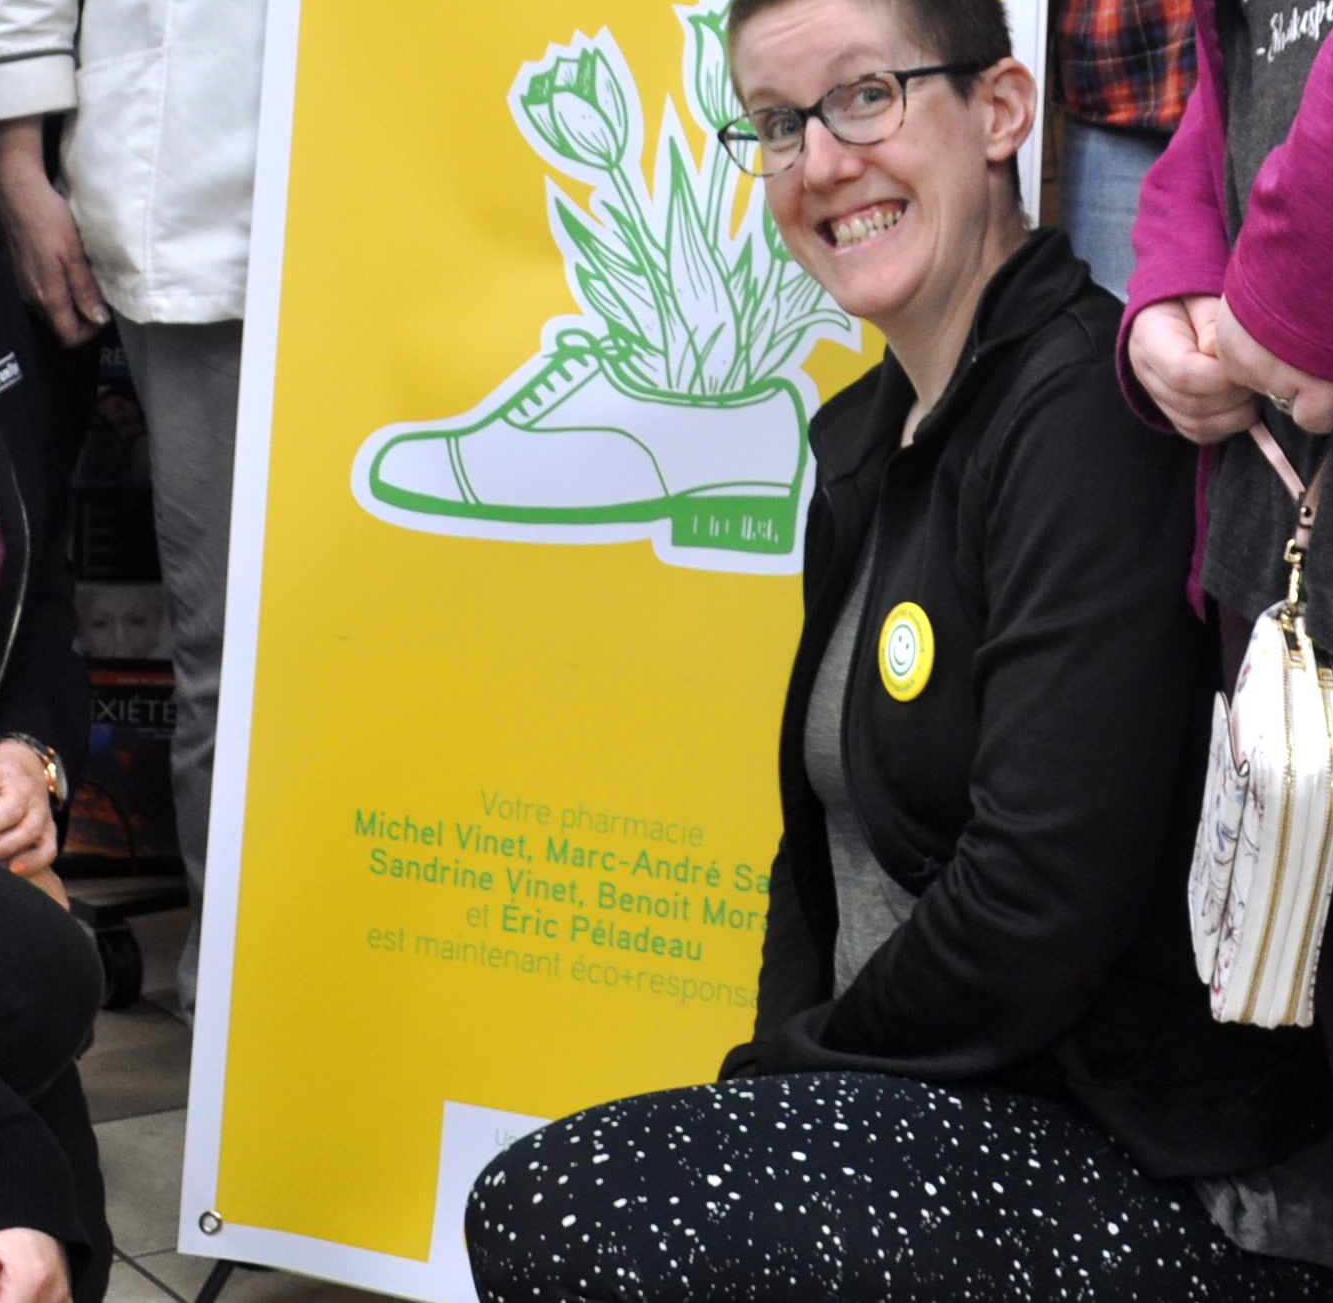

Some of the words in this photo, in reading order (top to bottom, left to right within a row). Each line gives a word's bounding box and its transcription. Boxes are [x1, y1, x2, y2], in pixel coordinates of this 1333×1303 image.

[354, 808, 444, 847] Michel
[456, 822, 533, 864] Vinet,
[545, 835, 722, 888] Marc-André
[480, 789, 551, 826] Votre
[561, 802, 704, 848] pharmacie
[369, 847, 493, 892] Sandrine
[506, 867, 584, 909] Vinet,
[598, 880, 689, 921] Benoit
[367, 927, 406, 952] est
[414, 934, 561, 977] maintenant
[466, 904, 490, 928] et
[502, 897, 558, 939] Éric
[571, 915, 702, 961] Péladeau
